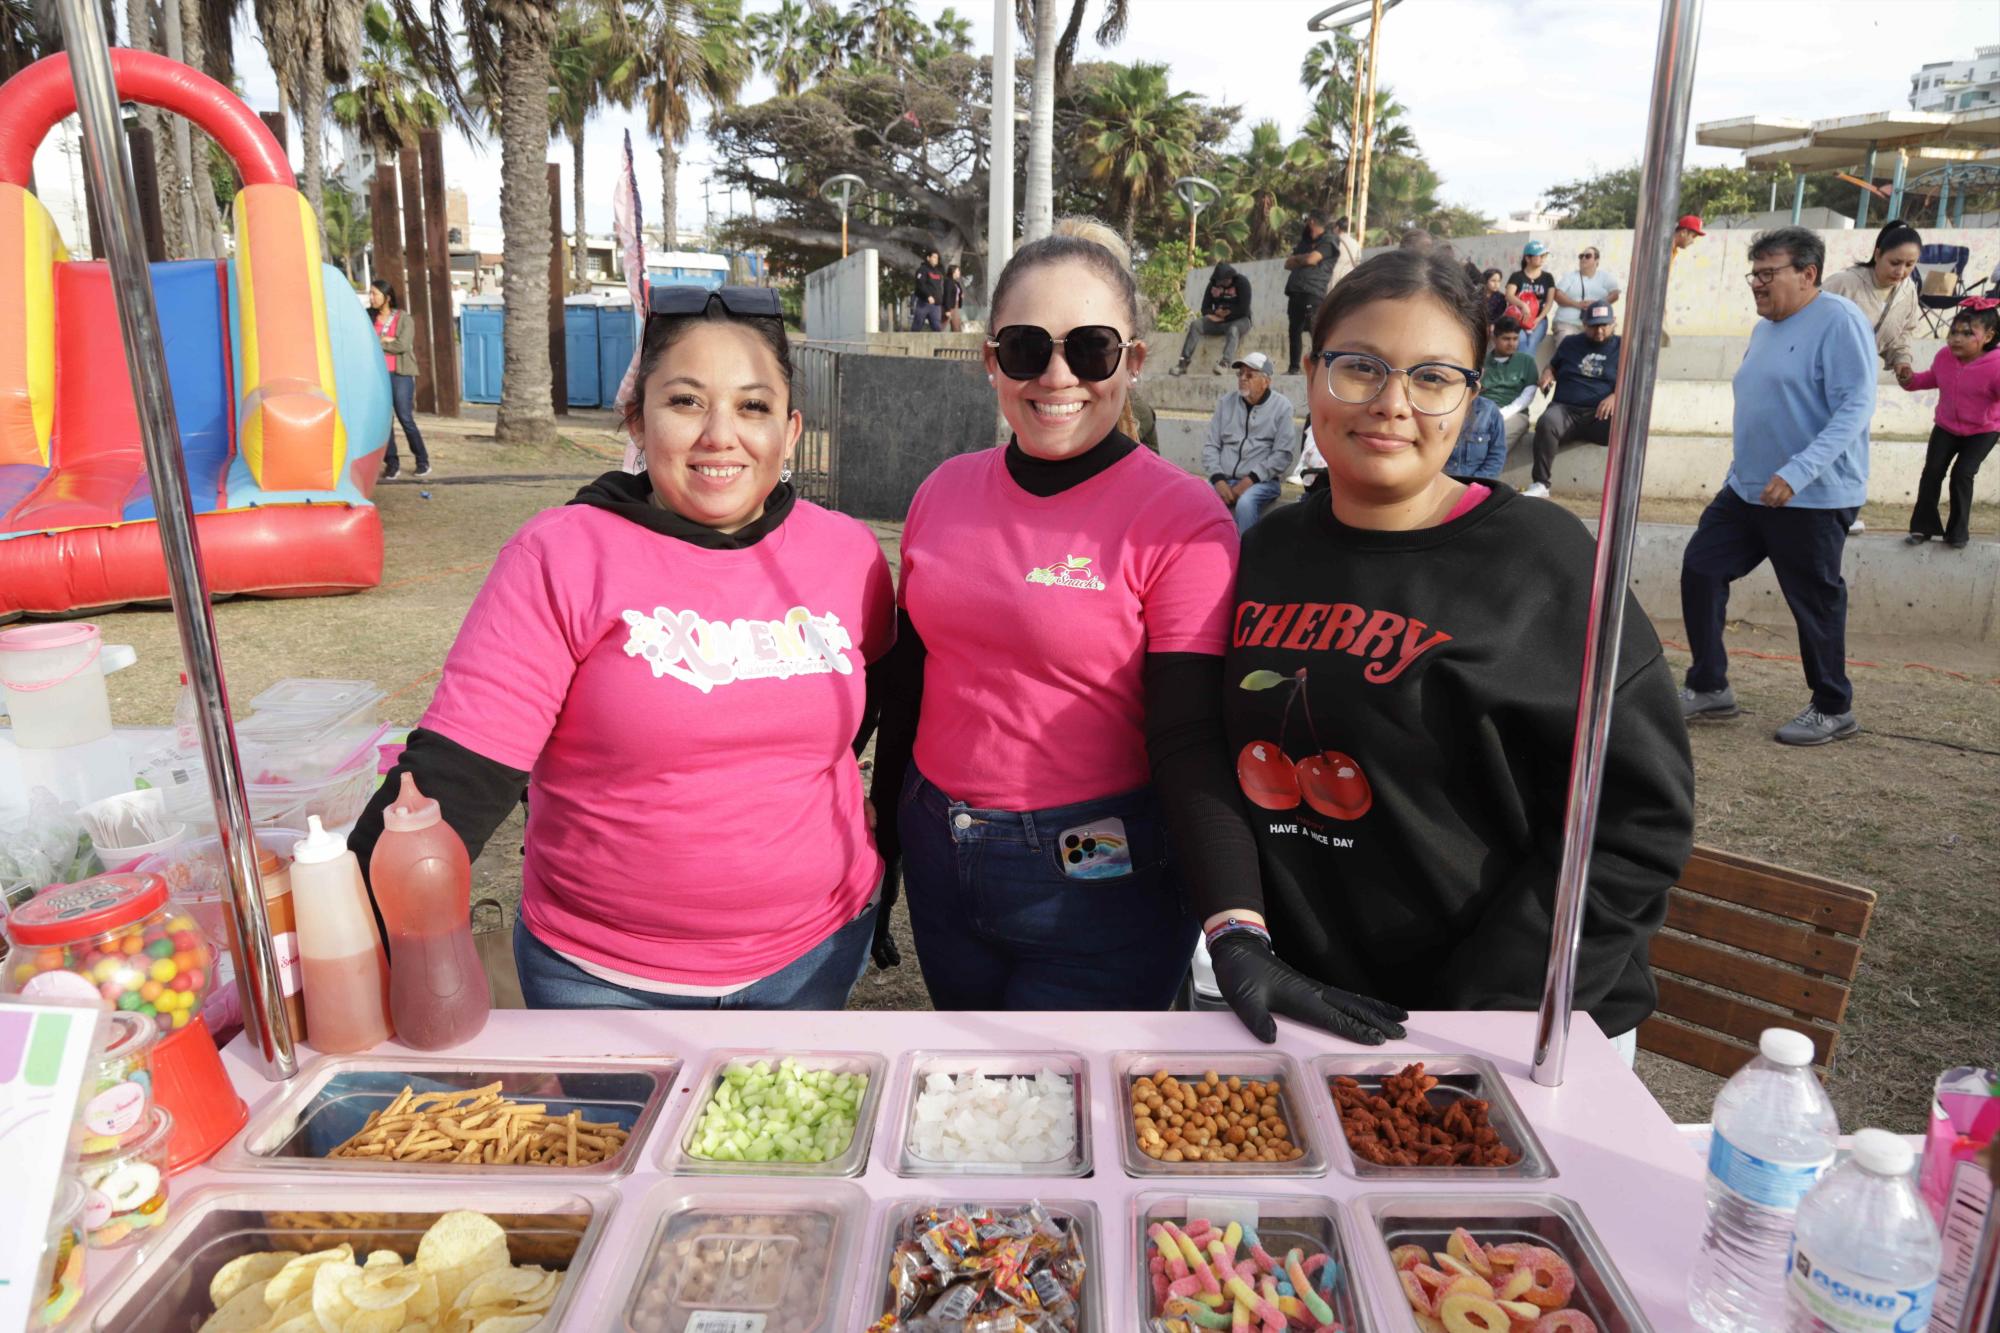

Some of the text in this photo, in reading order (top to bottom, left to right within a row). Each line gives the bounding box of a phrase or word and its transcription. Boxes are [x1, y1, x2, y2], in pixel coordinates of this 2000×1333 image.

[1233, 600, 1453, 684] CHERRY
[1269, 823, 1298, 834] HAVE
[1302, 827, 1309, 836] A
[1333, 836, 1354, 848] DAY
